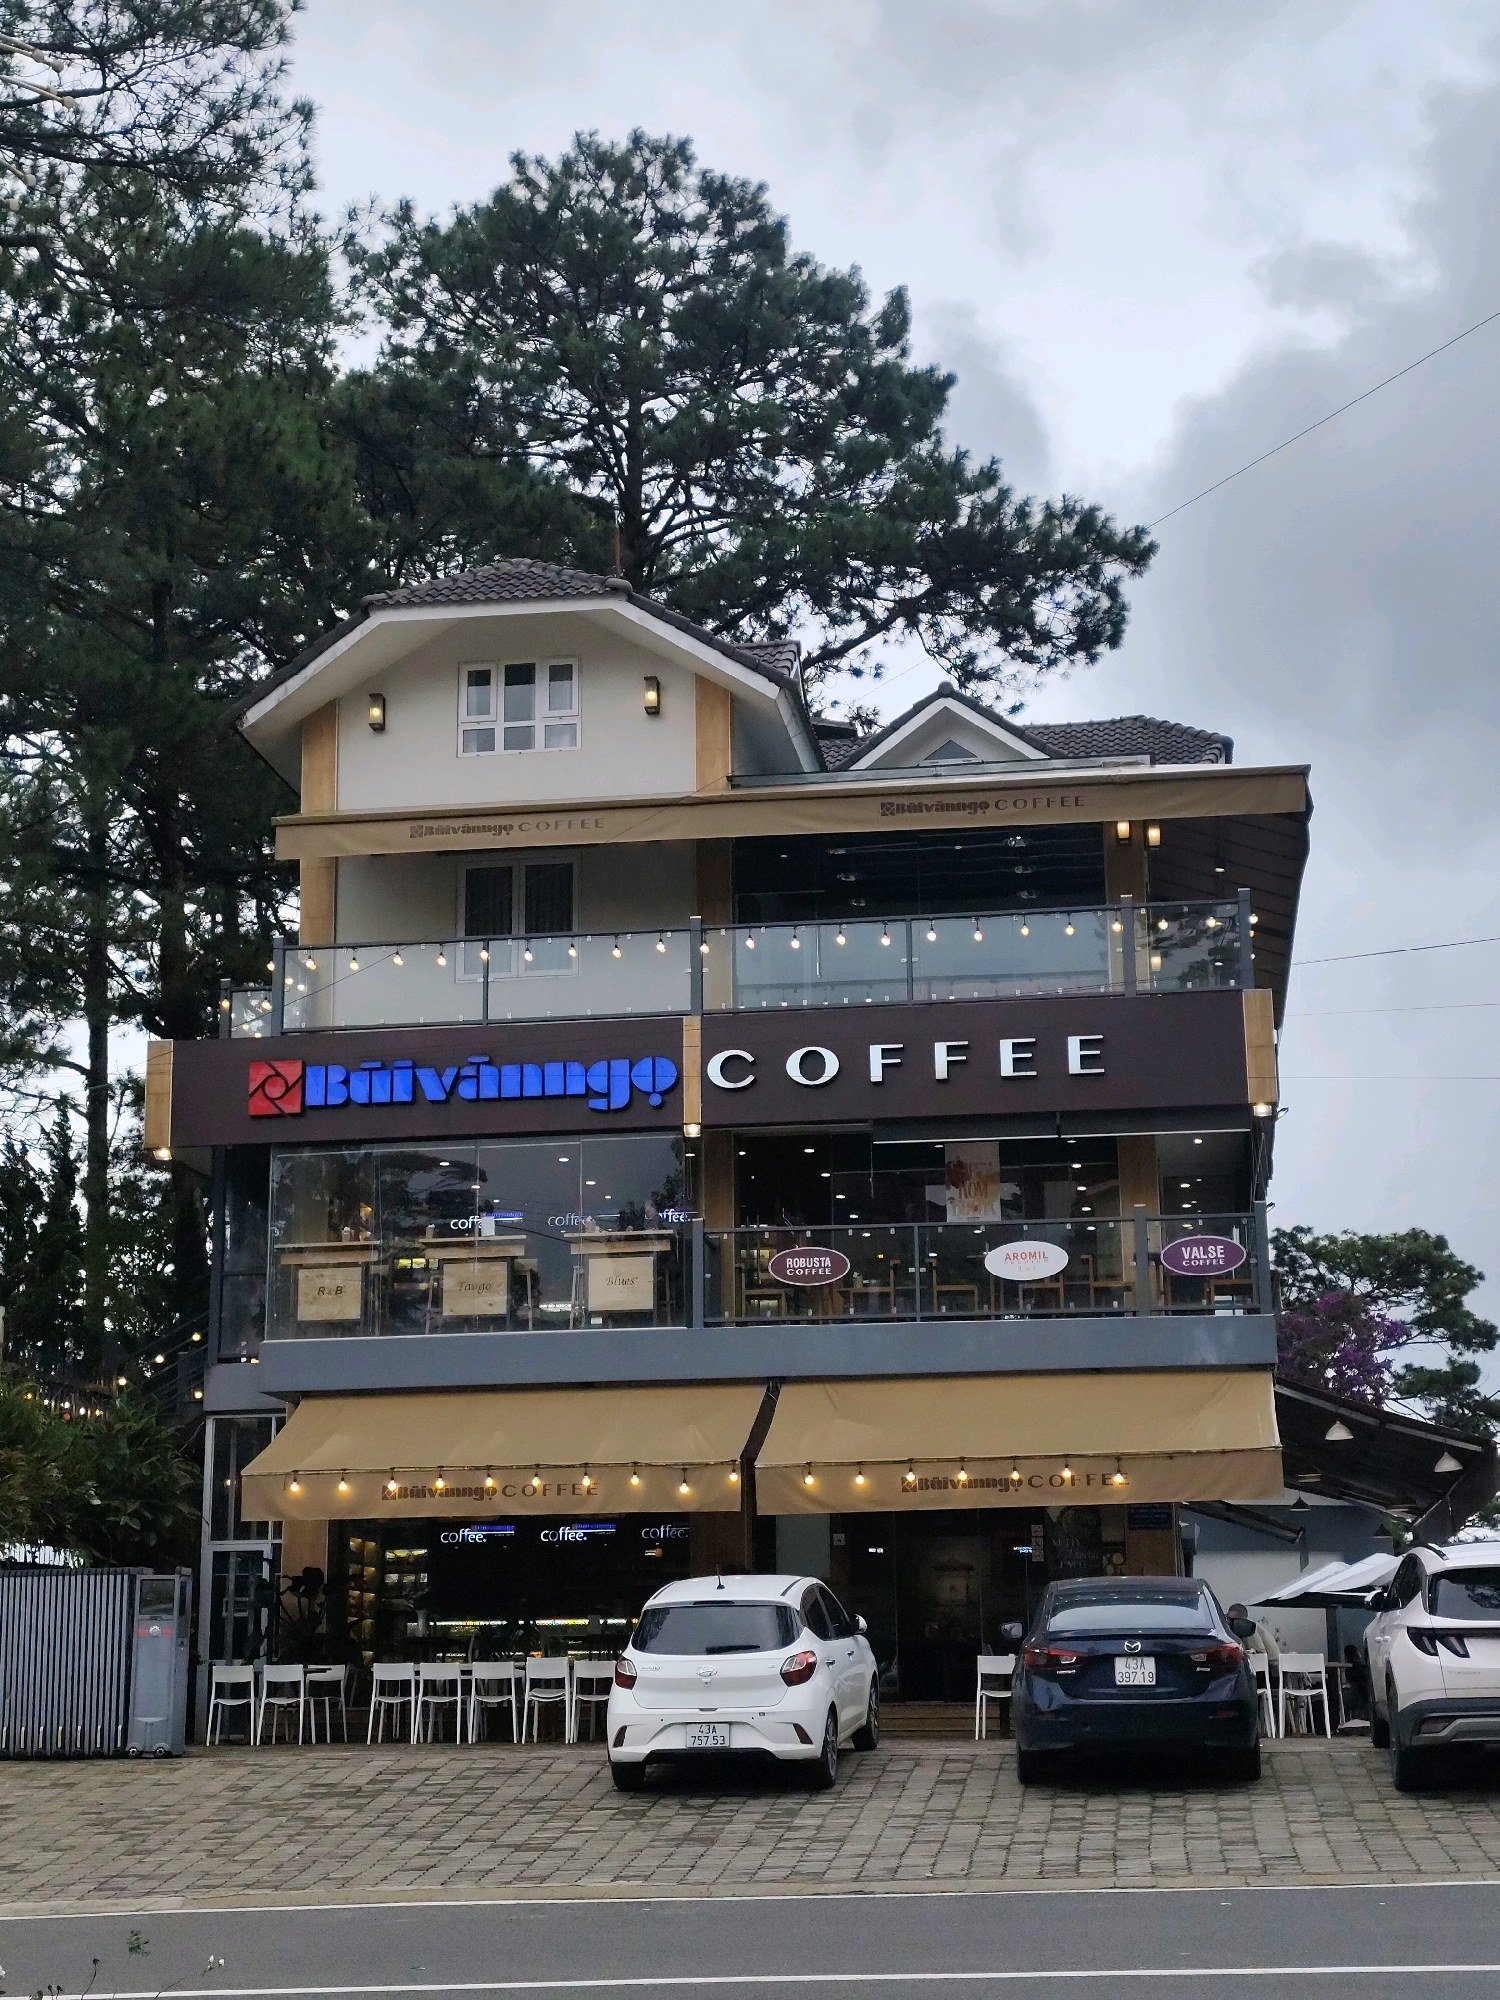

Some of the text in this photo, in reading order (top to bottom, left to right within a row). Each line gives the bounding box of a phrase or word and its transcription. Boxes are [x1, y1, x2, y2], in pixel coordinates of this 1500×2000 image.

[994, 795, 1086, 810] COFFEE
[518, 817, 605, 832] COFFEE
[707, 1033, 1106, 1090] COFFEE
[1004, 1250, 1049, 1262] AROMIL
[1181, 1245, 1225, 1259] VALSE
[786, 1257, 832, 1268] ROBUSTA
[1182, 1258, 1226, 1267] COFFEE
[786, 1267, 832, 1276] COFFEE
[605, 1275, 635, 1286] Blues
[458, 1281, 492, 1294] Tango
[501, 1482, 598, 1498] COFFEE
[1124, 1656, 1146, 1670] 43A
[1117, 1671, 1154, 1684] 397.19
[698, 1725, 717, 1735] 43A
[690, 1735, 726, 1746] 757.53
